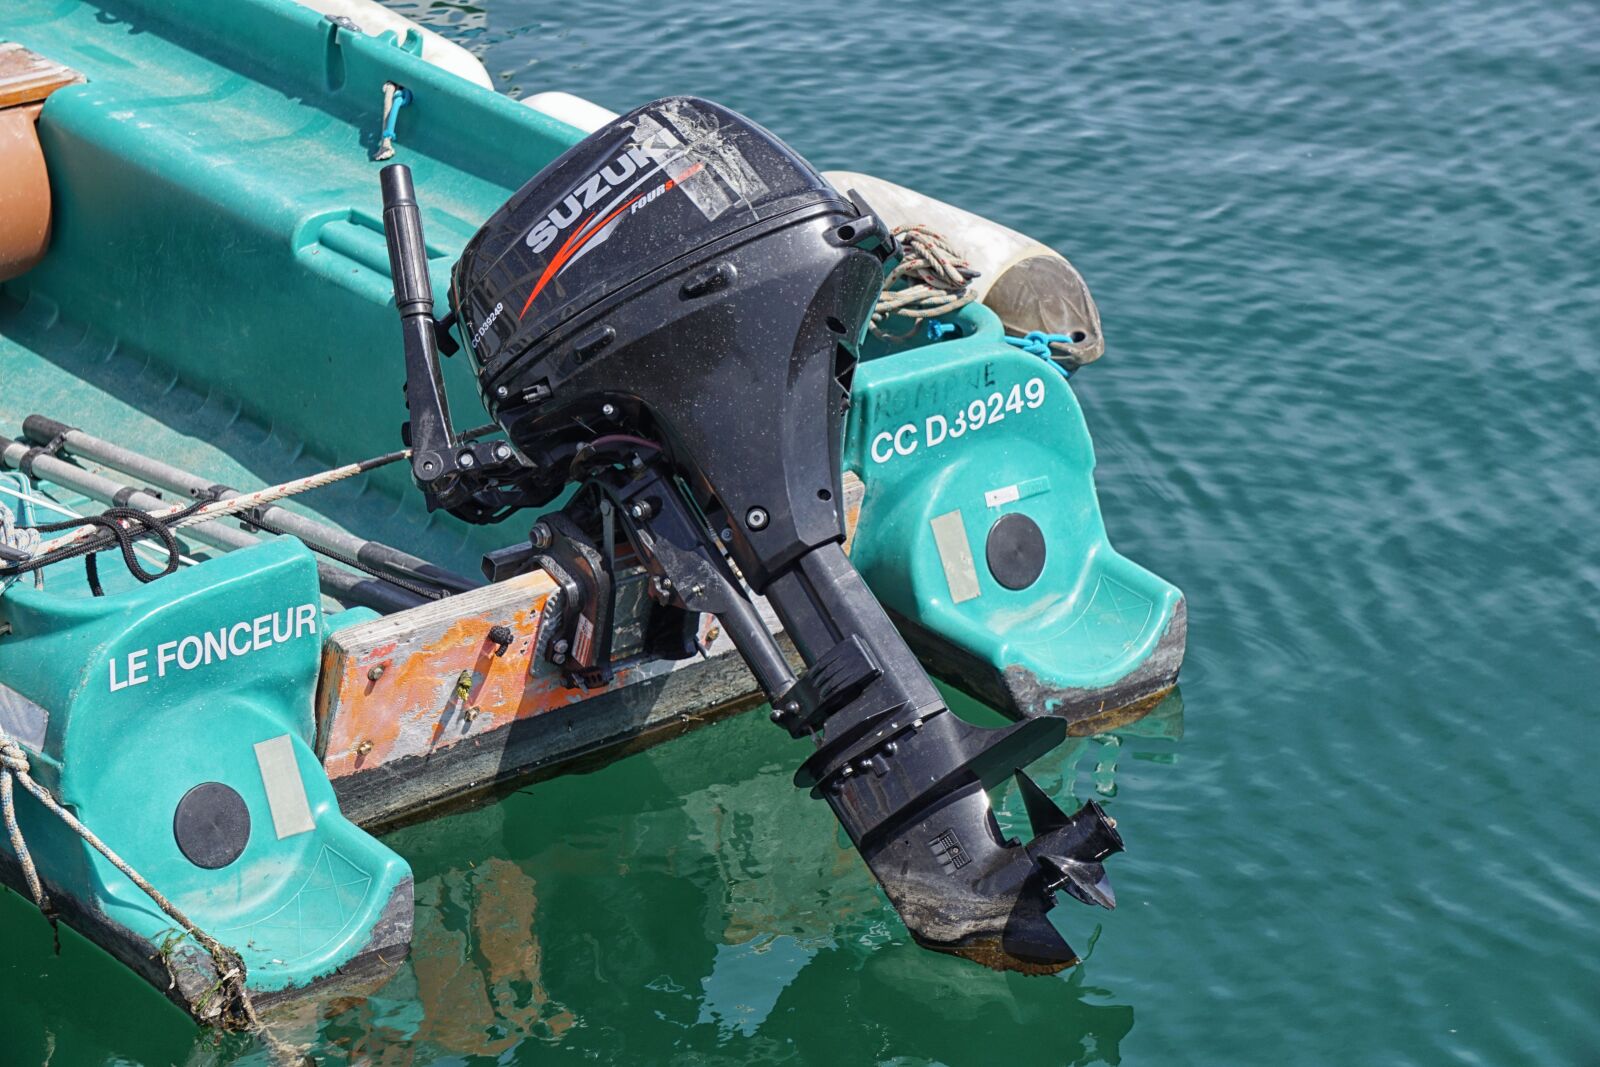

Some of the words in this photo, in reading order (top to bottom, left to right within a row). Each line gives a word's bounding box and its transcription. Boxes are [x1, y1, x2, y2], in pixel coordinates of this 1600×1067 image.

[525, 127, 681, 254] SUZUKI
[471, 333, 481, 349] CC
[478, 302, 504, 337] D39249
[870, 423, 919, 464] CC
[925, 377, 1046, 448] D39249
[109, 648, 149, 693] LE
[157, 603, 317, 677] FONCEUR
